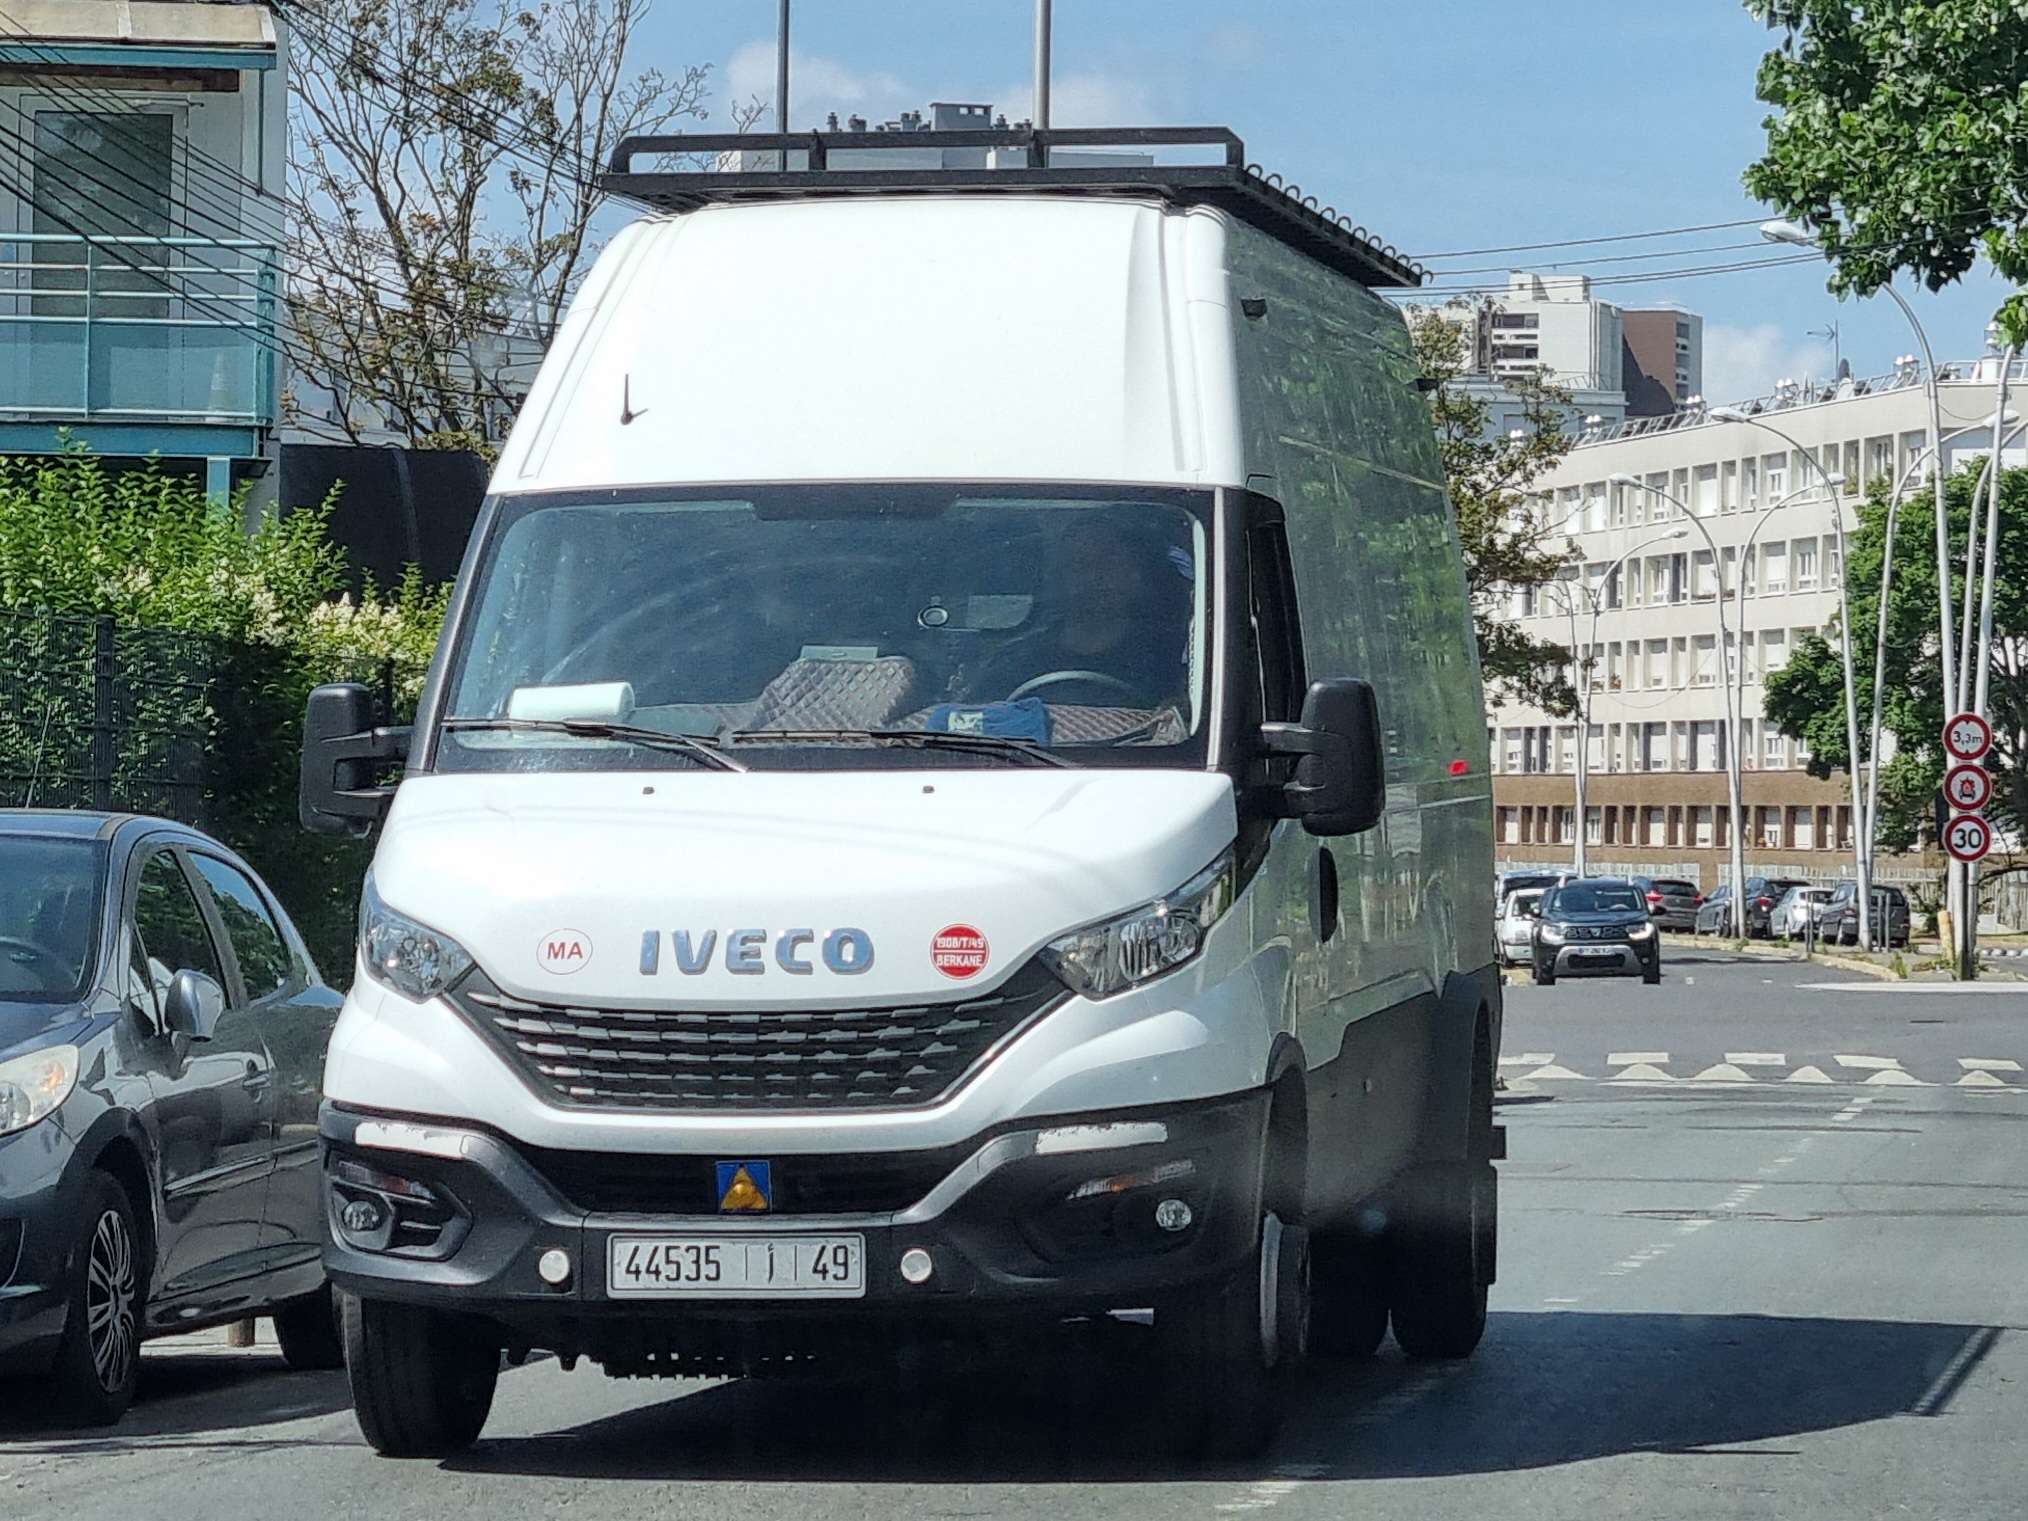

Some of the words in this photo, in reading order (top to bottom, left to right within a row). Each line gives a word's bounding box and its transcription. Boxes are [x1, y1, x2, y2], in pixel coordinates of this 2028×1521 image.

[1954, 828, 1982, 849] 30
[547, 941, 583, 960] MA
[639, 927, 875, 976] IVECO
[936, 954, 983, 966] BERKANE
[625, 1245, 721, 1282] 44535
[811, 1245, 849, 1281] 49
